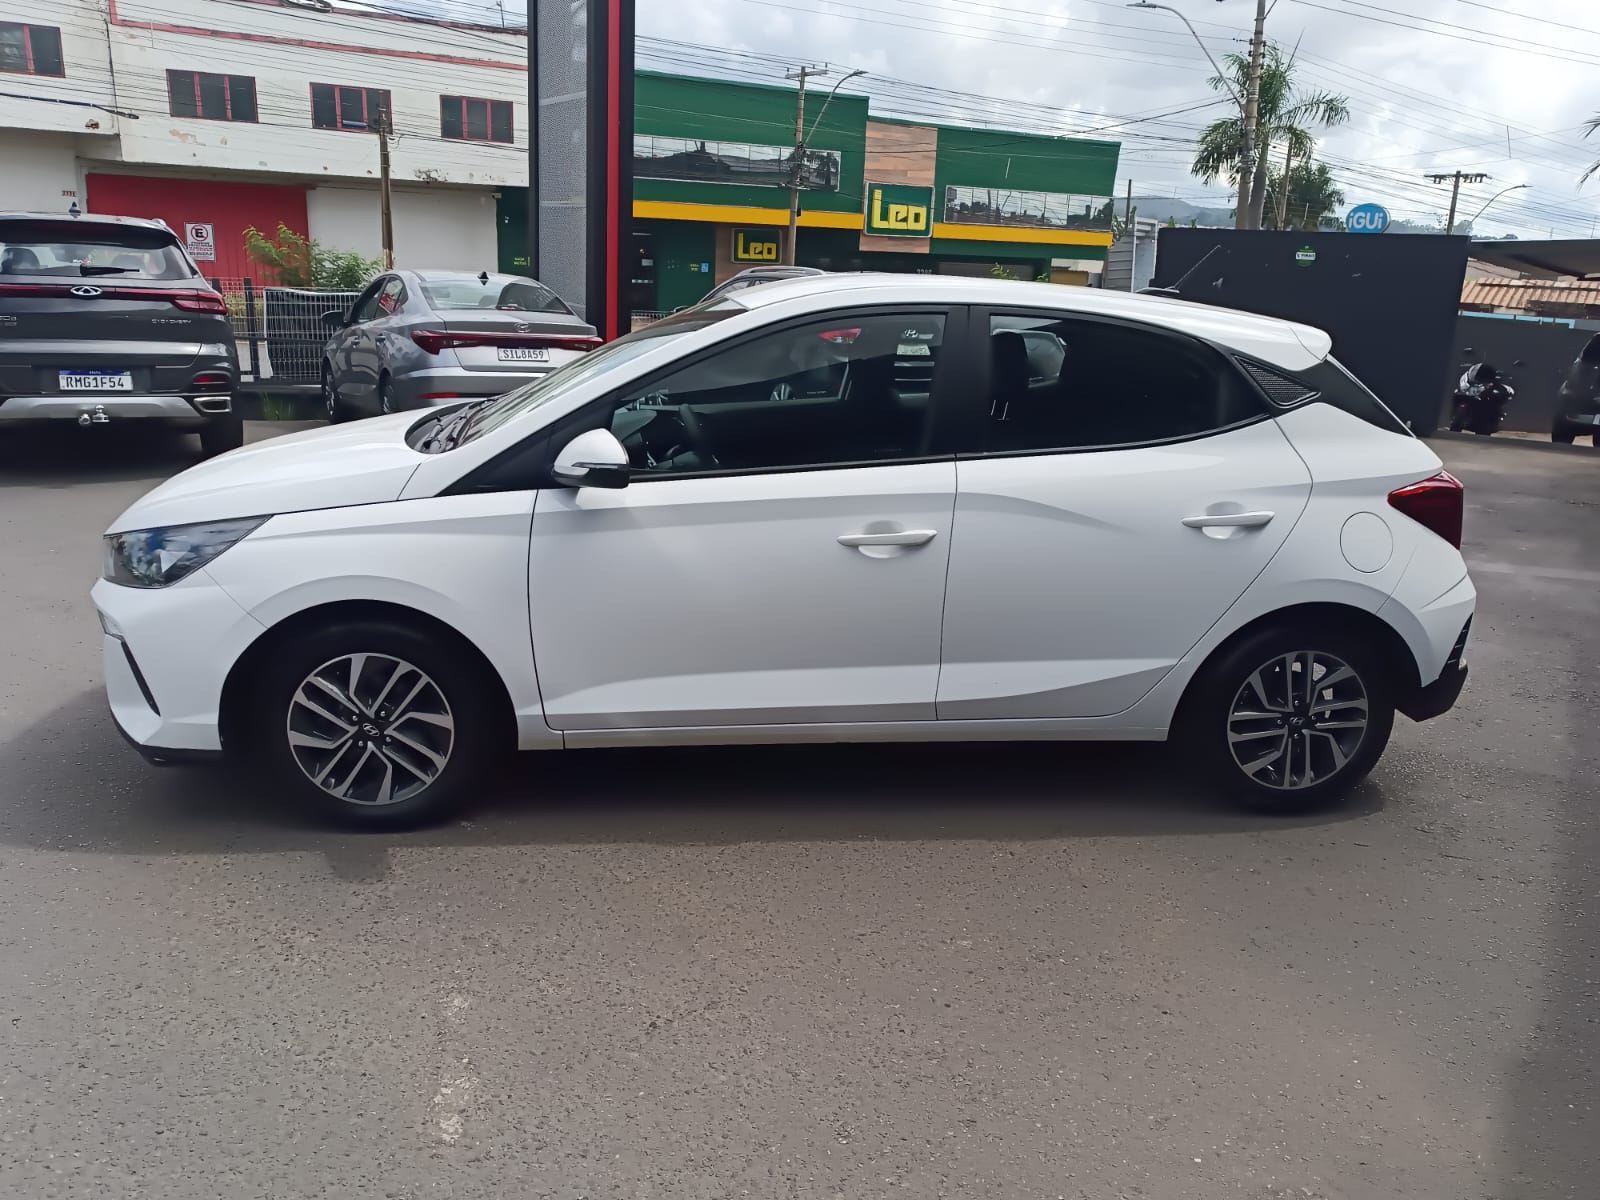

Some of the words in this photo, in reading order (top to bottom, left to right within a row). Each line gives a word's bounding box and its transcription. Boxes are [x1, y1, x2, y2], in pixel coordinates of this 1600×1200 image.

[872, 189, 927, 231] Leo
[1348, 211, 1383, 230] iGUi
[194, 228, 204, 238] E
[737, 233, 778, 260] Leo
[503, 349, 544, 359] SIL8A59
[66, 376, 124, 388] RMG1F54
